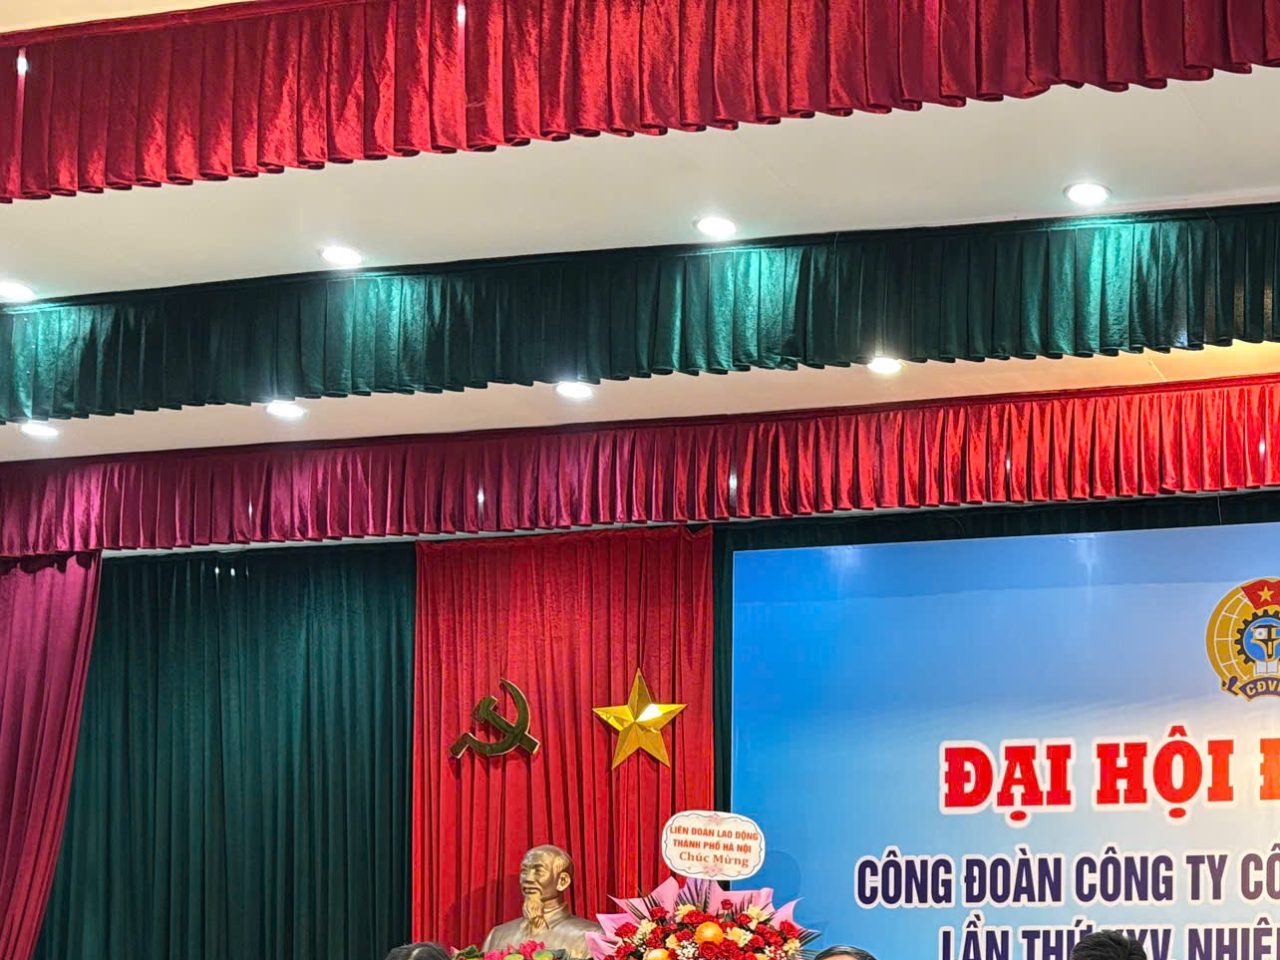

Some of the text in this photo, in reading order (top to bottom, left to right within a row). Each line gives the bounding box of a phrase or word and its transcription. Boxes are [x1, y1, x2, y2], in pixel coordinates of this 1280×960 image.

[944, 744, 1071, 821] ĐẠI
[1096, 725, 1234, 819] HỘI
[717, 830, 733, 838] LAO
[736, 843, 752, 854] NỘI
[679, 851, 749, 868] Chúc Mừng
[857, 850, 952, 905] CÔNG
[964, 848, 1062, 903] ĐOÀN
[1075, 846, 1174, 903] CÔNG
[1186, 854, 1228, 901] TY
